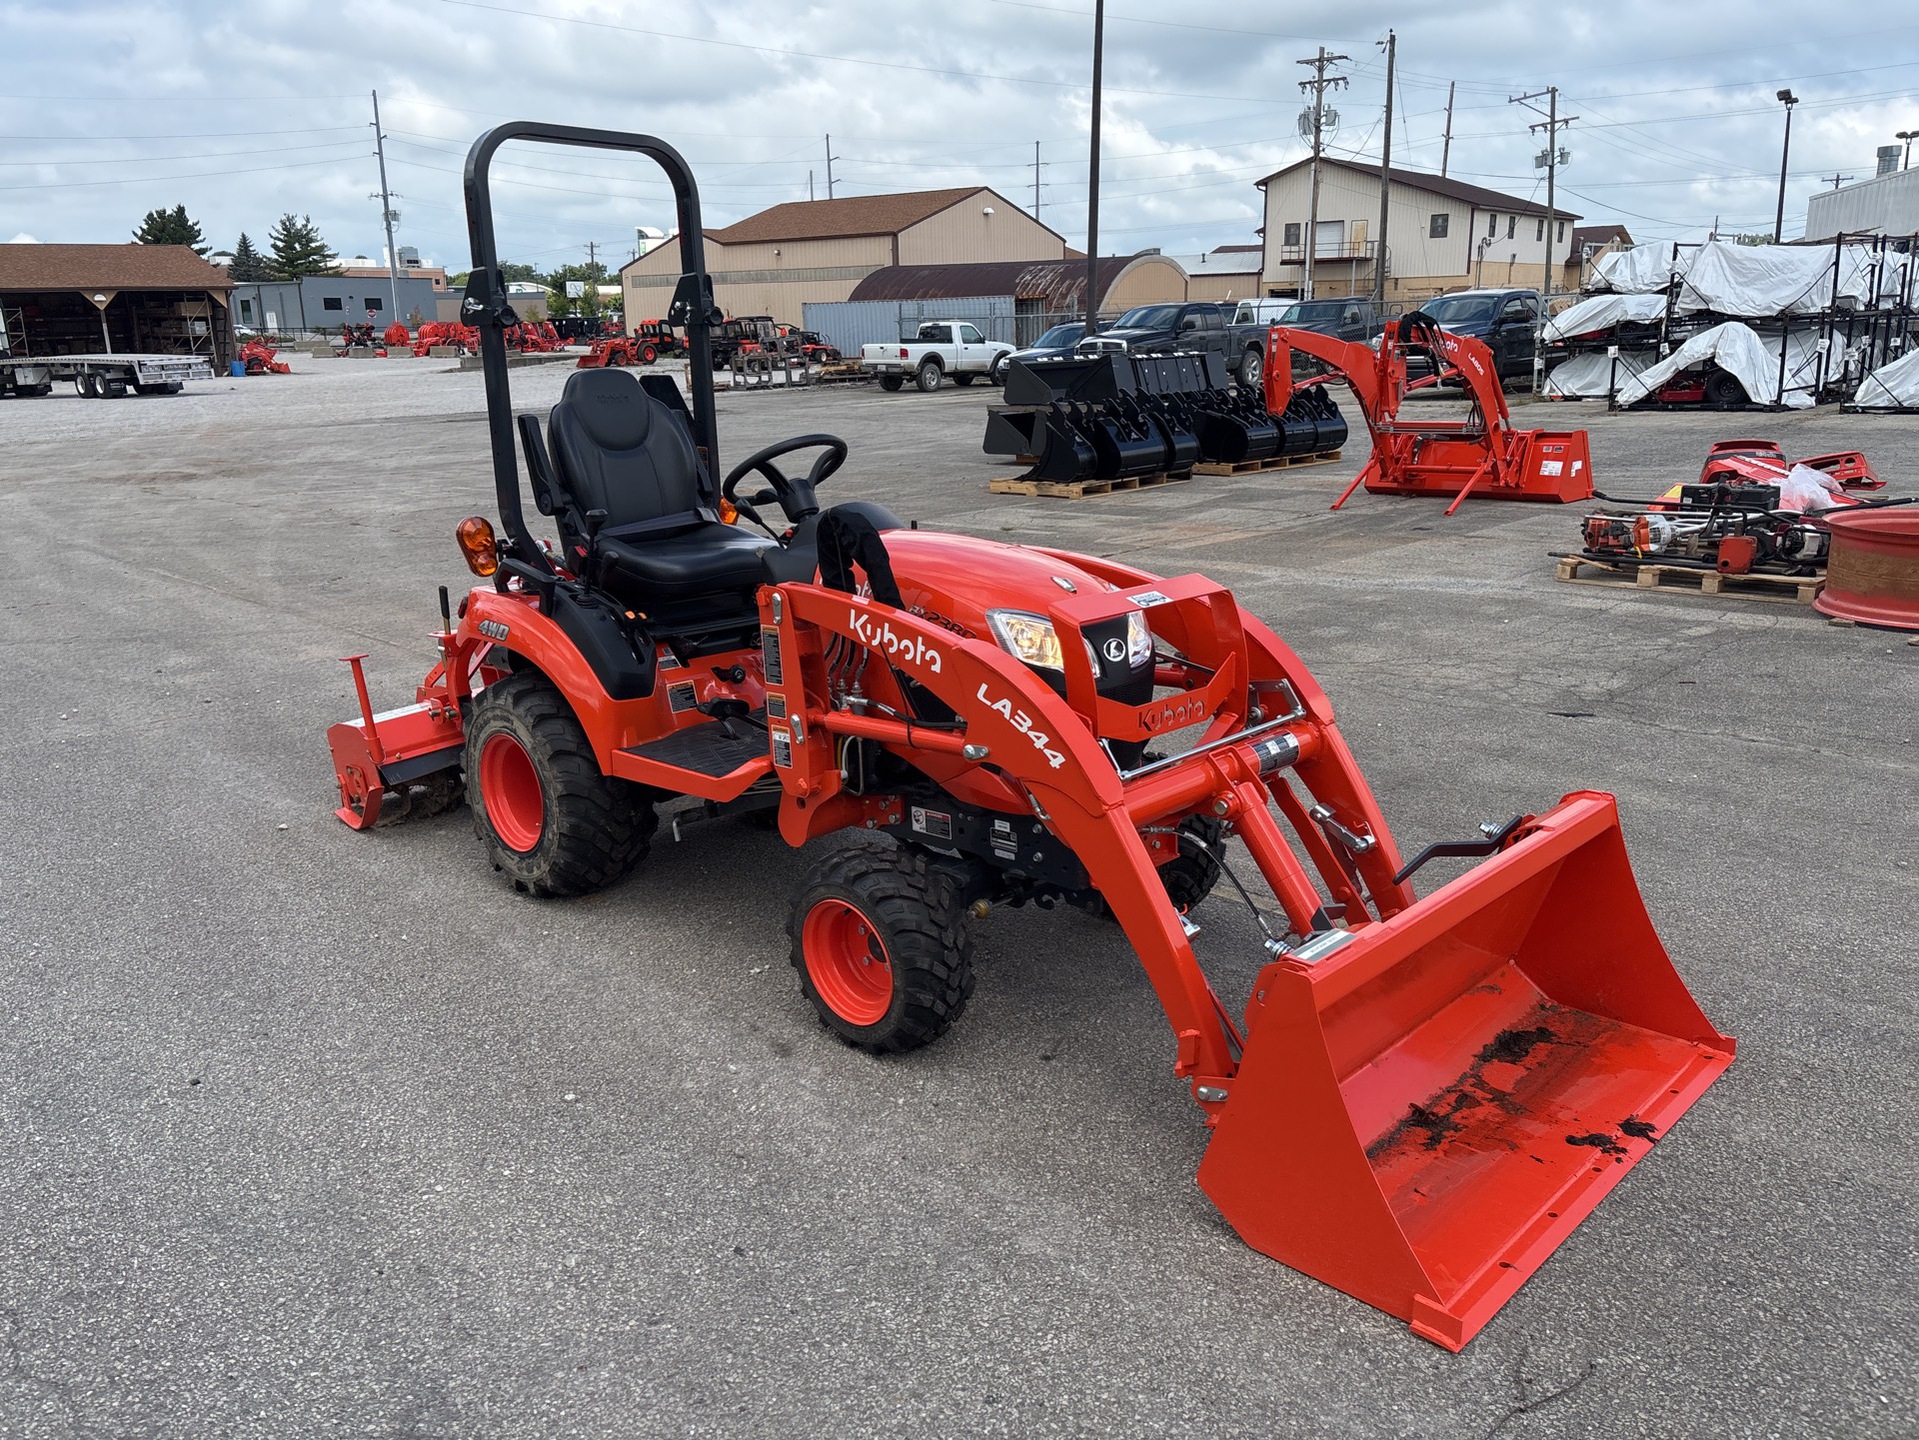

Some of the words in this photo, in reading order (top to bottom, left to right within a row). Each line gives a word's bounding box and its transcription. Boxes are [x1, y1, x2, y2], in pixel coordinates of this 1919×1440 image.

[478, 619, 510, 641] 4WD
[849, 608, 942, 674] Kubota
[976, 682, 1066, 769] LA344
[1138, 696, 1205, 732] Kubota
